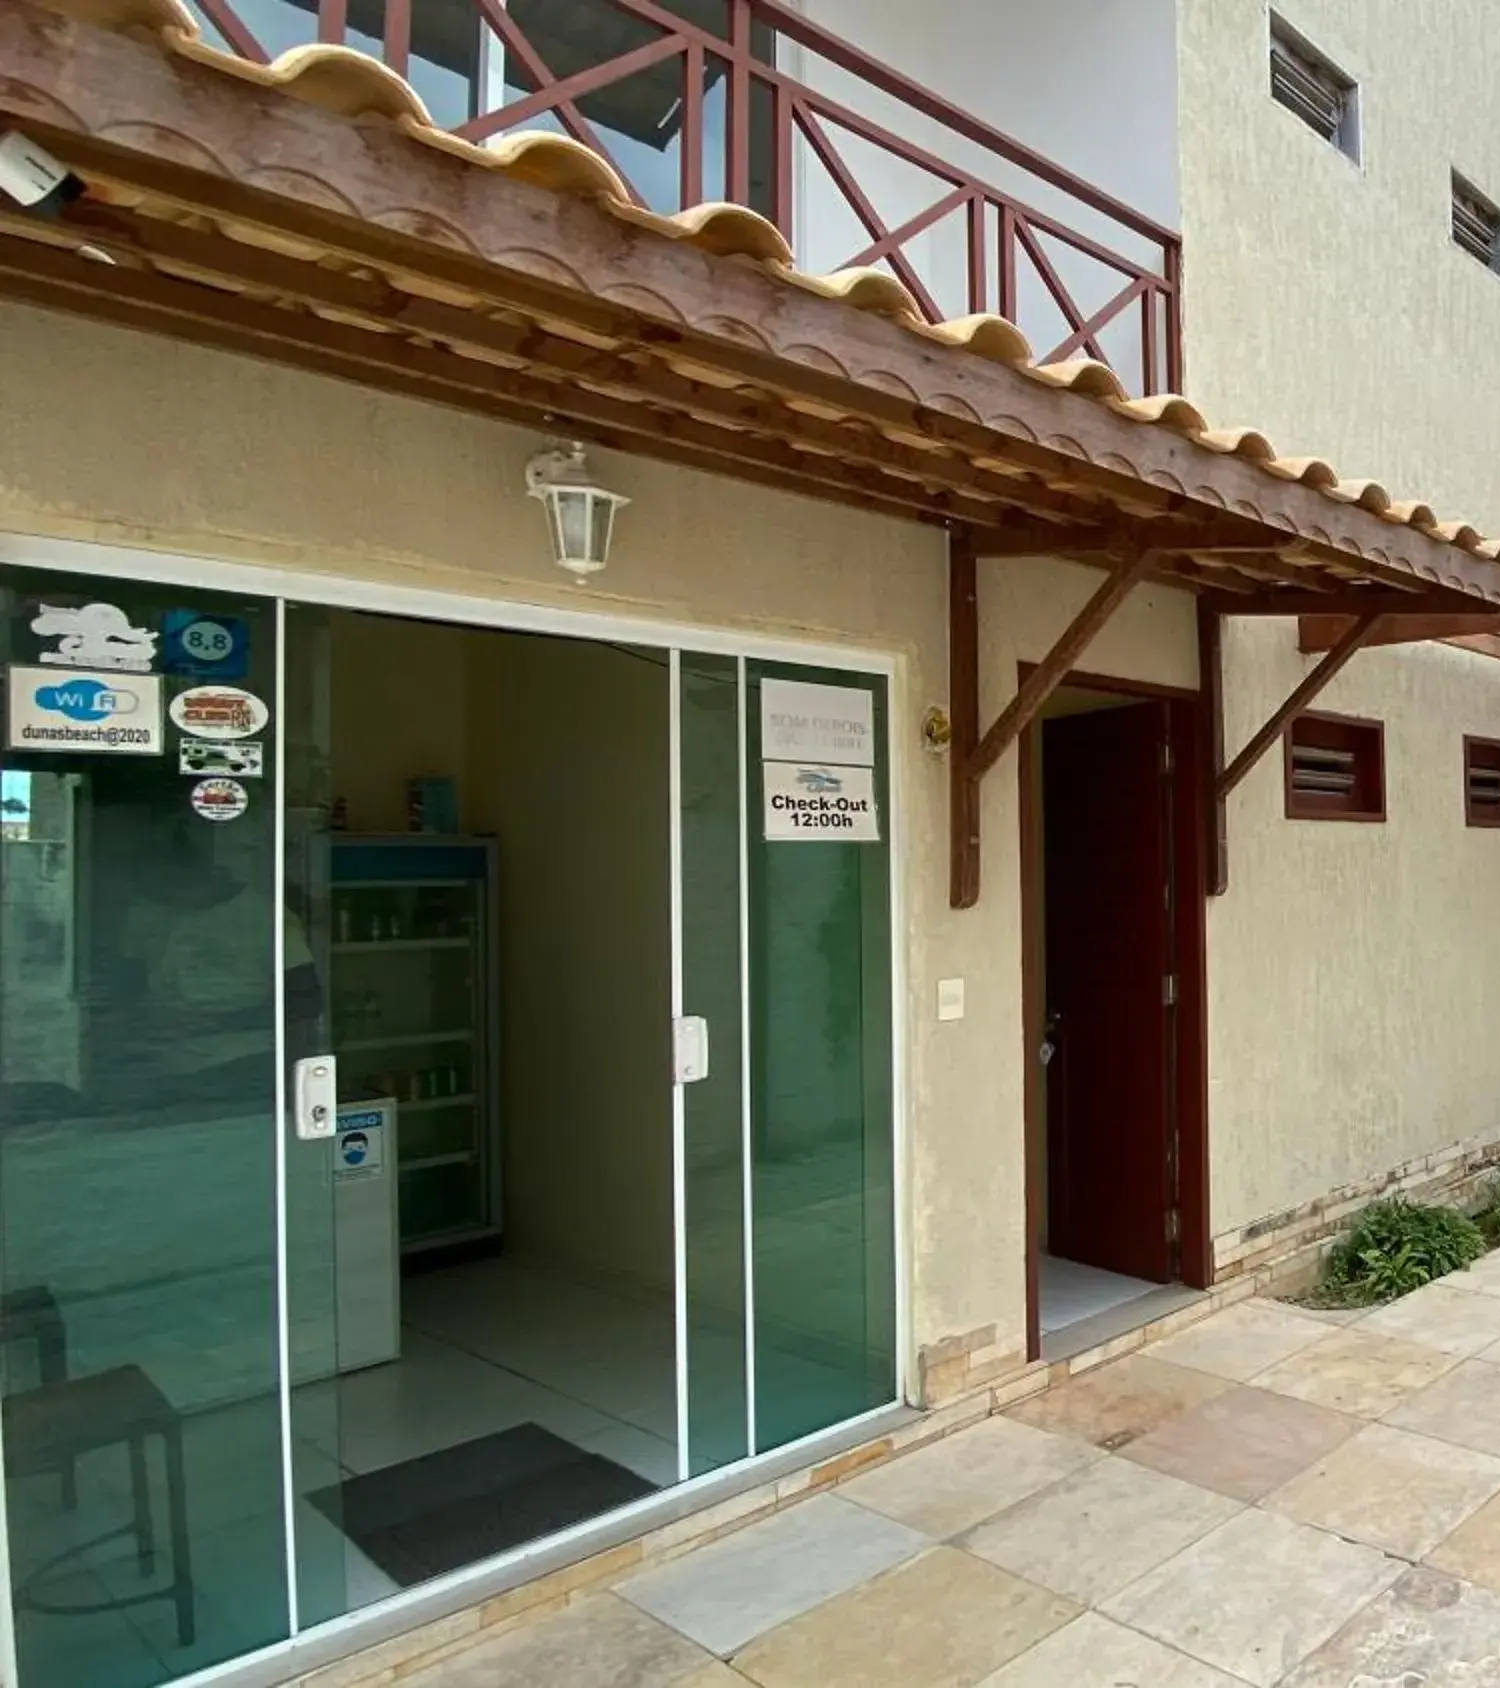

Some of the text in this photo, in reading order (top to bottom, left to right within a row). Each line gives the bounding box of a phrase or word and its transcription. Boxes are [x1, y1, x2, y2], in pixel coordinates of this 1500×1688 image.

[22, 723, 151, 746] dunasbeach@2020
[771, 795, 868, 812] Check-Out
[790, 813, 853, 828] 12:00h
